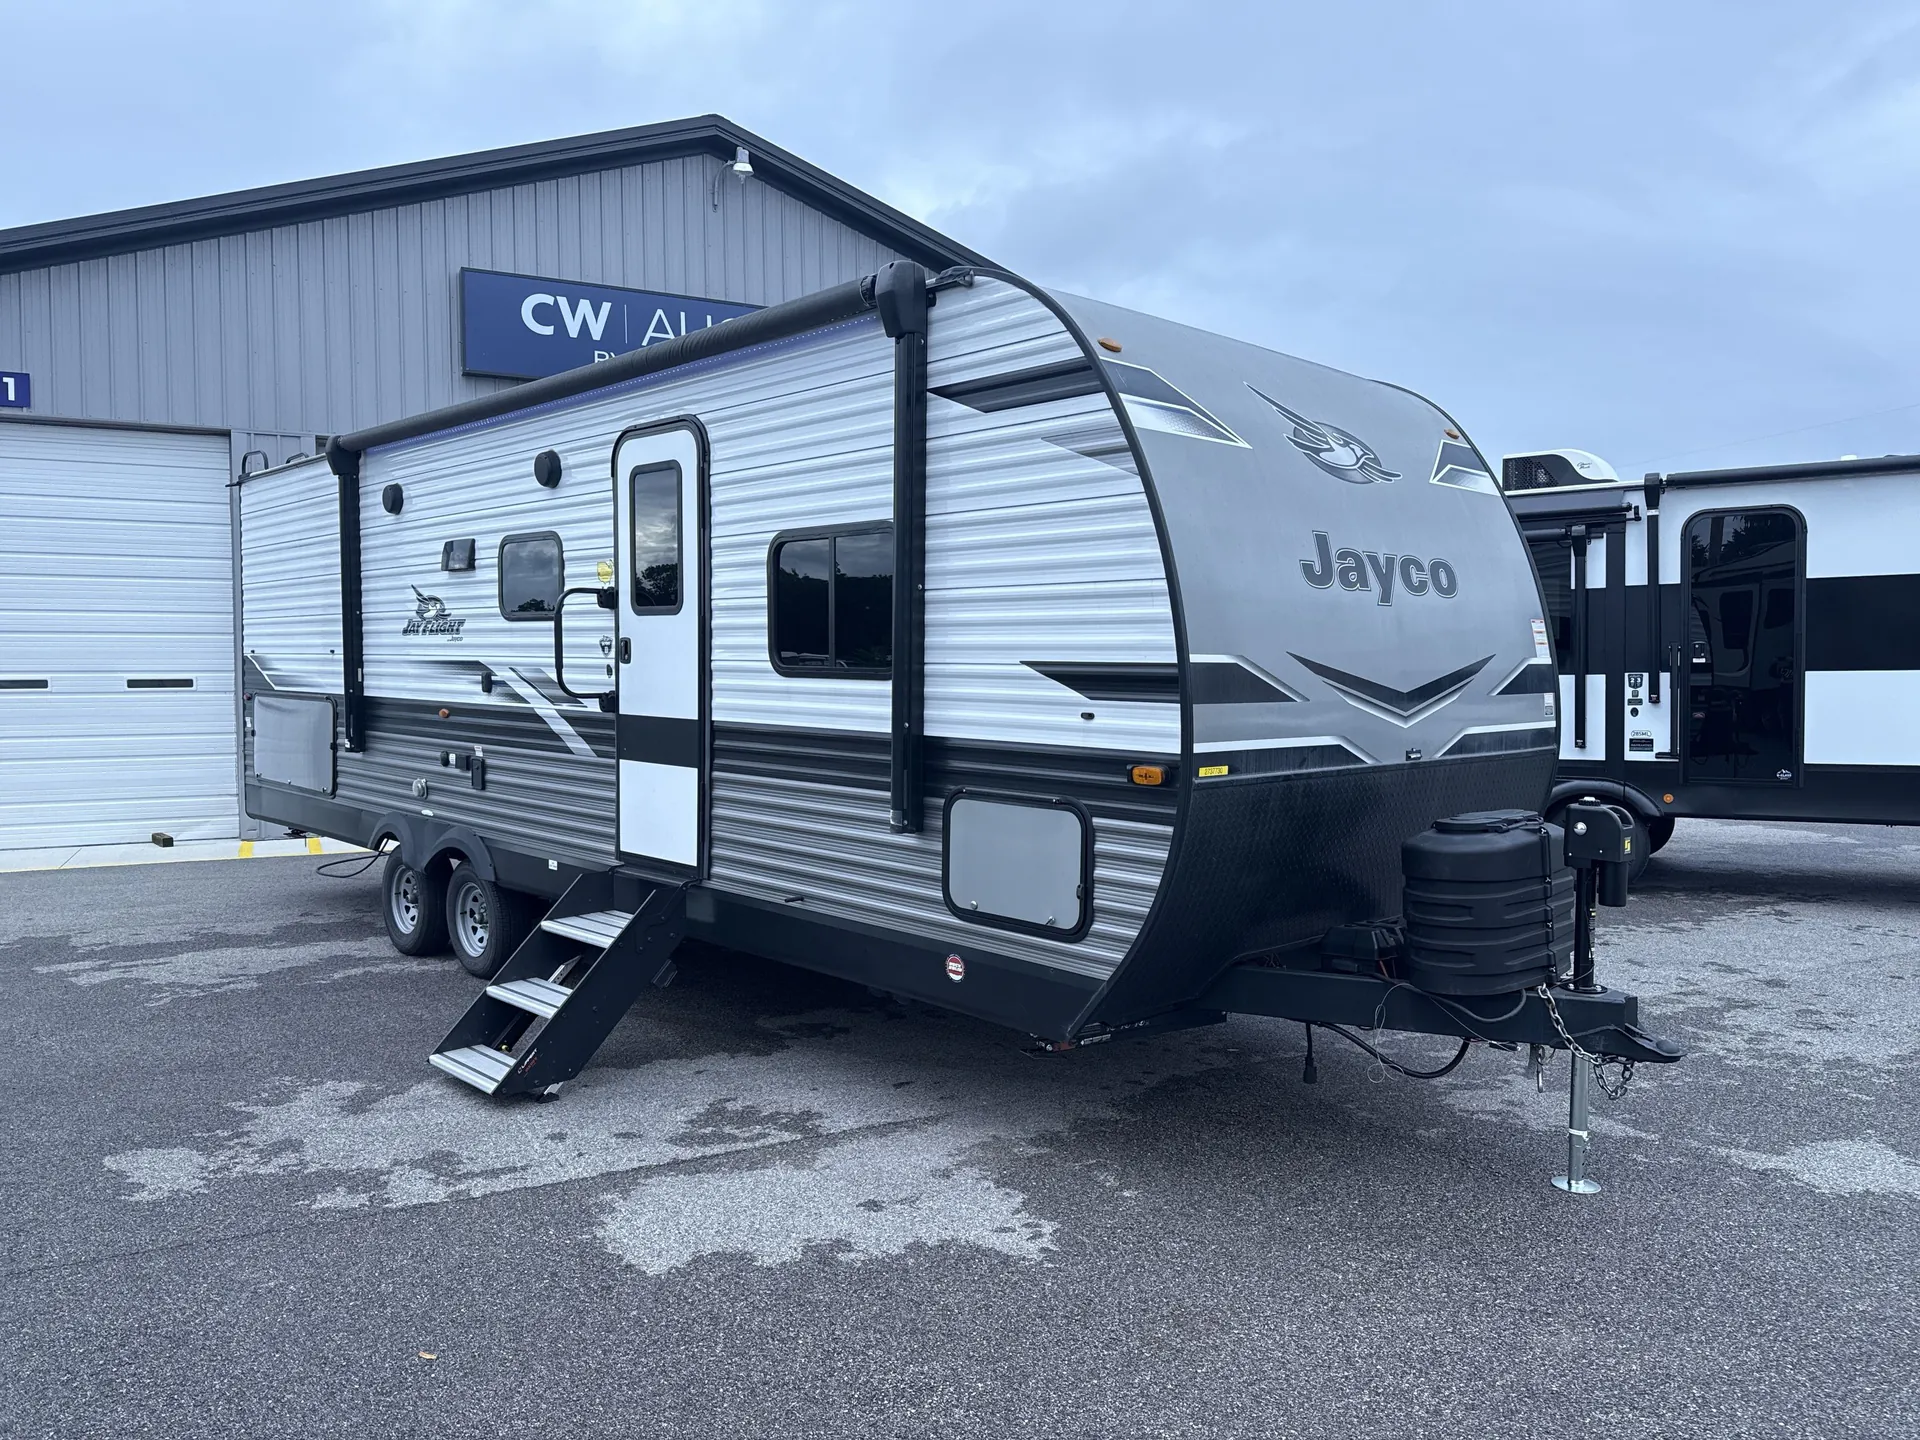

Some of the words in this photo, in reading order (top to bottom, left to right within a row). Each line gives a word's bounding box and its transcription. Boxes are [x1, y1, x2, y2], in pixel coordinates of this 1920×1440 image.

[520, 293, 612, 341] CW
[2, 376, 15, 401] 1
[1299, 530, 1459, 607] Jayco
[402, 619, 424, 636] JAY
[421, 619, 467, 636] FLIGHT
